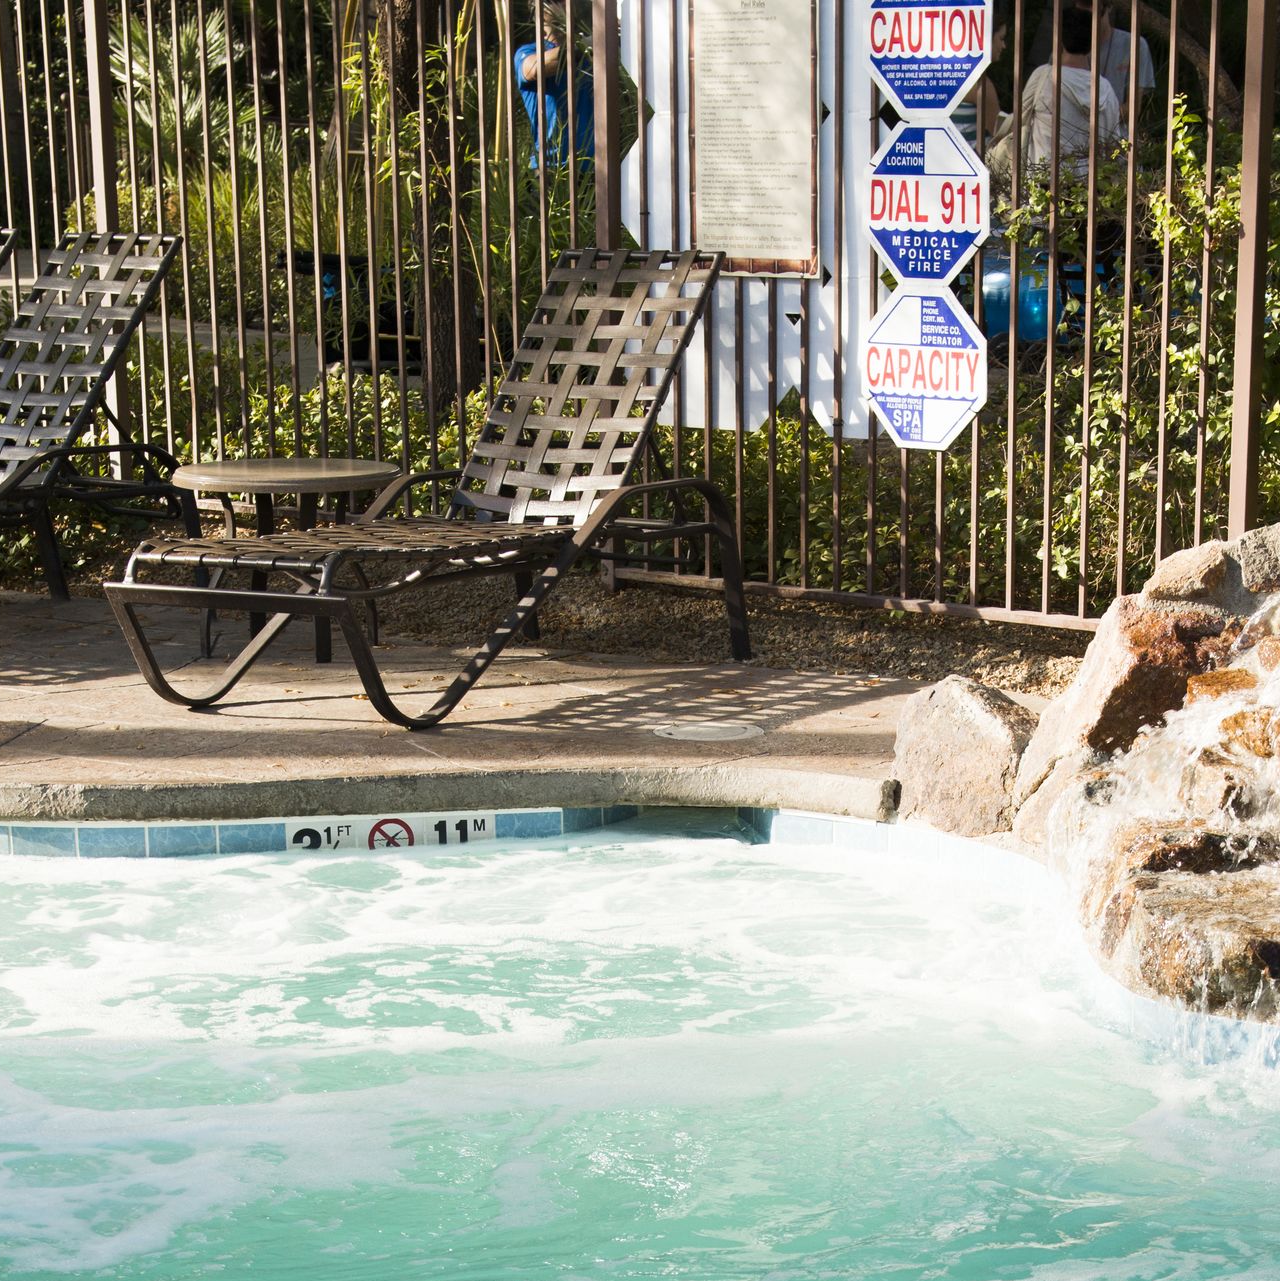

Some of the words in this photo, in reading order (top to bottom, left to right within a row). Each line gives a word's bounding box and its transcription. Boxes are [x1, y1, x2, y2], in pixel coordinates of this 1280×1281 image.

[870, 9, 984, 54] CAUTION
[895, 142, 924, 153] PHONE
[887, 157, 924, 166] LOCATION
[870, 179, 928, 222] DIAL
[941, 182, 980, 224] 911
[892, 236, 958, 248] MEDICAL
[899, 248, 952, 260] POLICE
[908, 262, 940, 272] FIRE
[922, 325, 948, 334] SERVICE
[950, 326, 961, 335] CO.
[922, 336, 962, 346] OPERATOR
[866, 346, 980, 392] CAPACITY
[893, 409, 921, 427] SPA
[337, 825, 352, 837] FT
